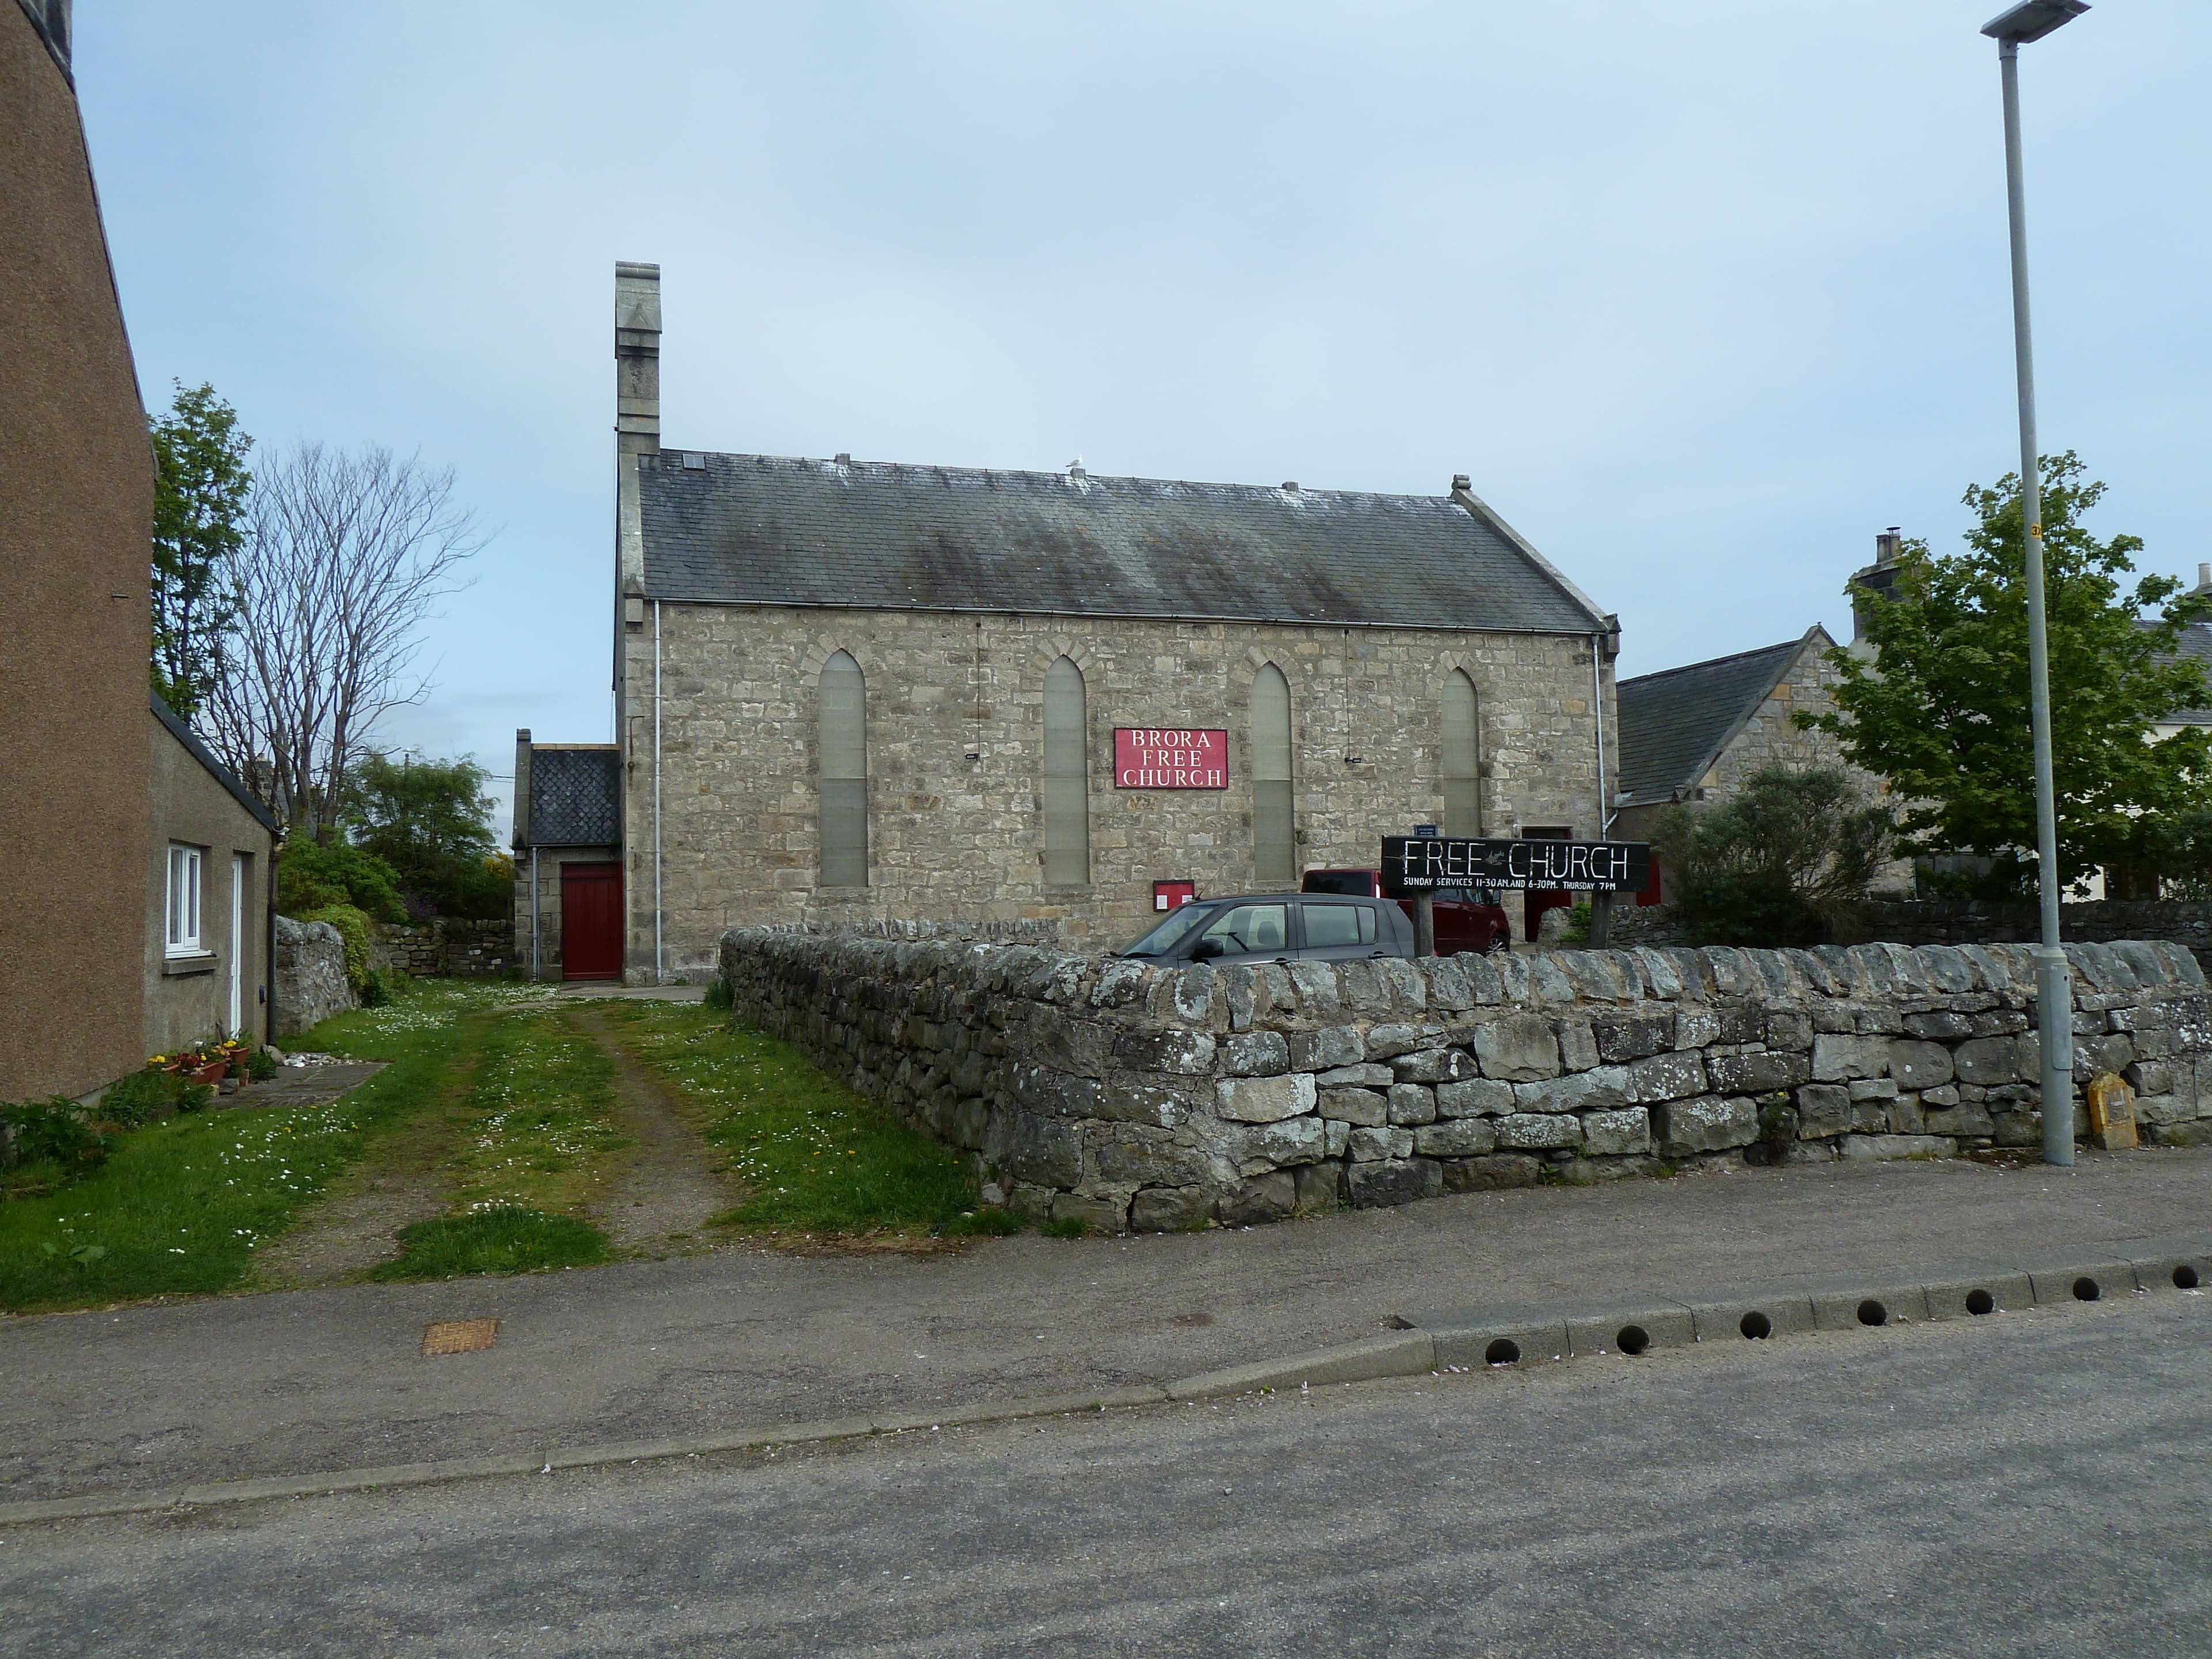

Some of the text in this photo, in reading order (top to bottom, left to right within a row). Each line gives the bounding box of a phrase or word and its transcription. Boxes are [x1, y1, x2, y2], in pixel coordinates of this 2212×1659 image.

[1131, 730, 1211, 747] BRORA
[1143, 749, 1202, 766] FREE
[1123, 770, 1221, 786] CHURCH
[1404, 841, 1628, 880] FREE CHURCH
[1403, 877, 1433, 886] SUNDAY
[1436, 877, 1472, 887] SERVICES
[1562, 881, 1595, 890] THURSDAY
[1599, 882, 1616, 891] 7PM
